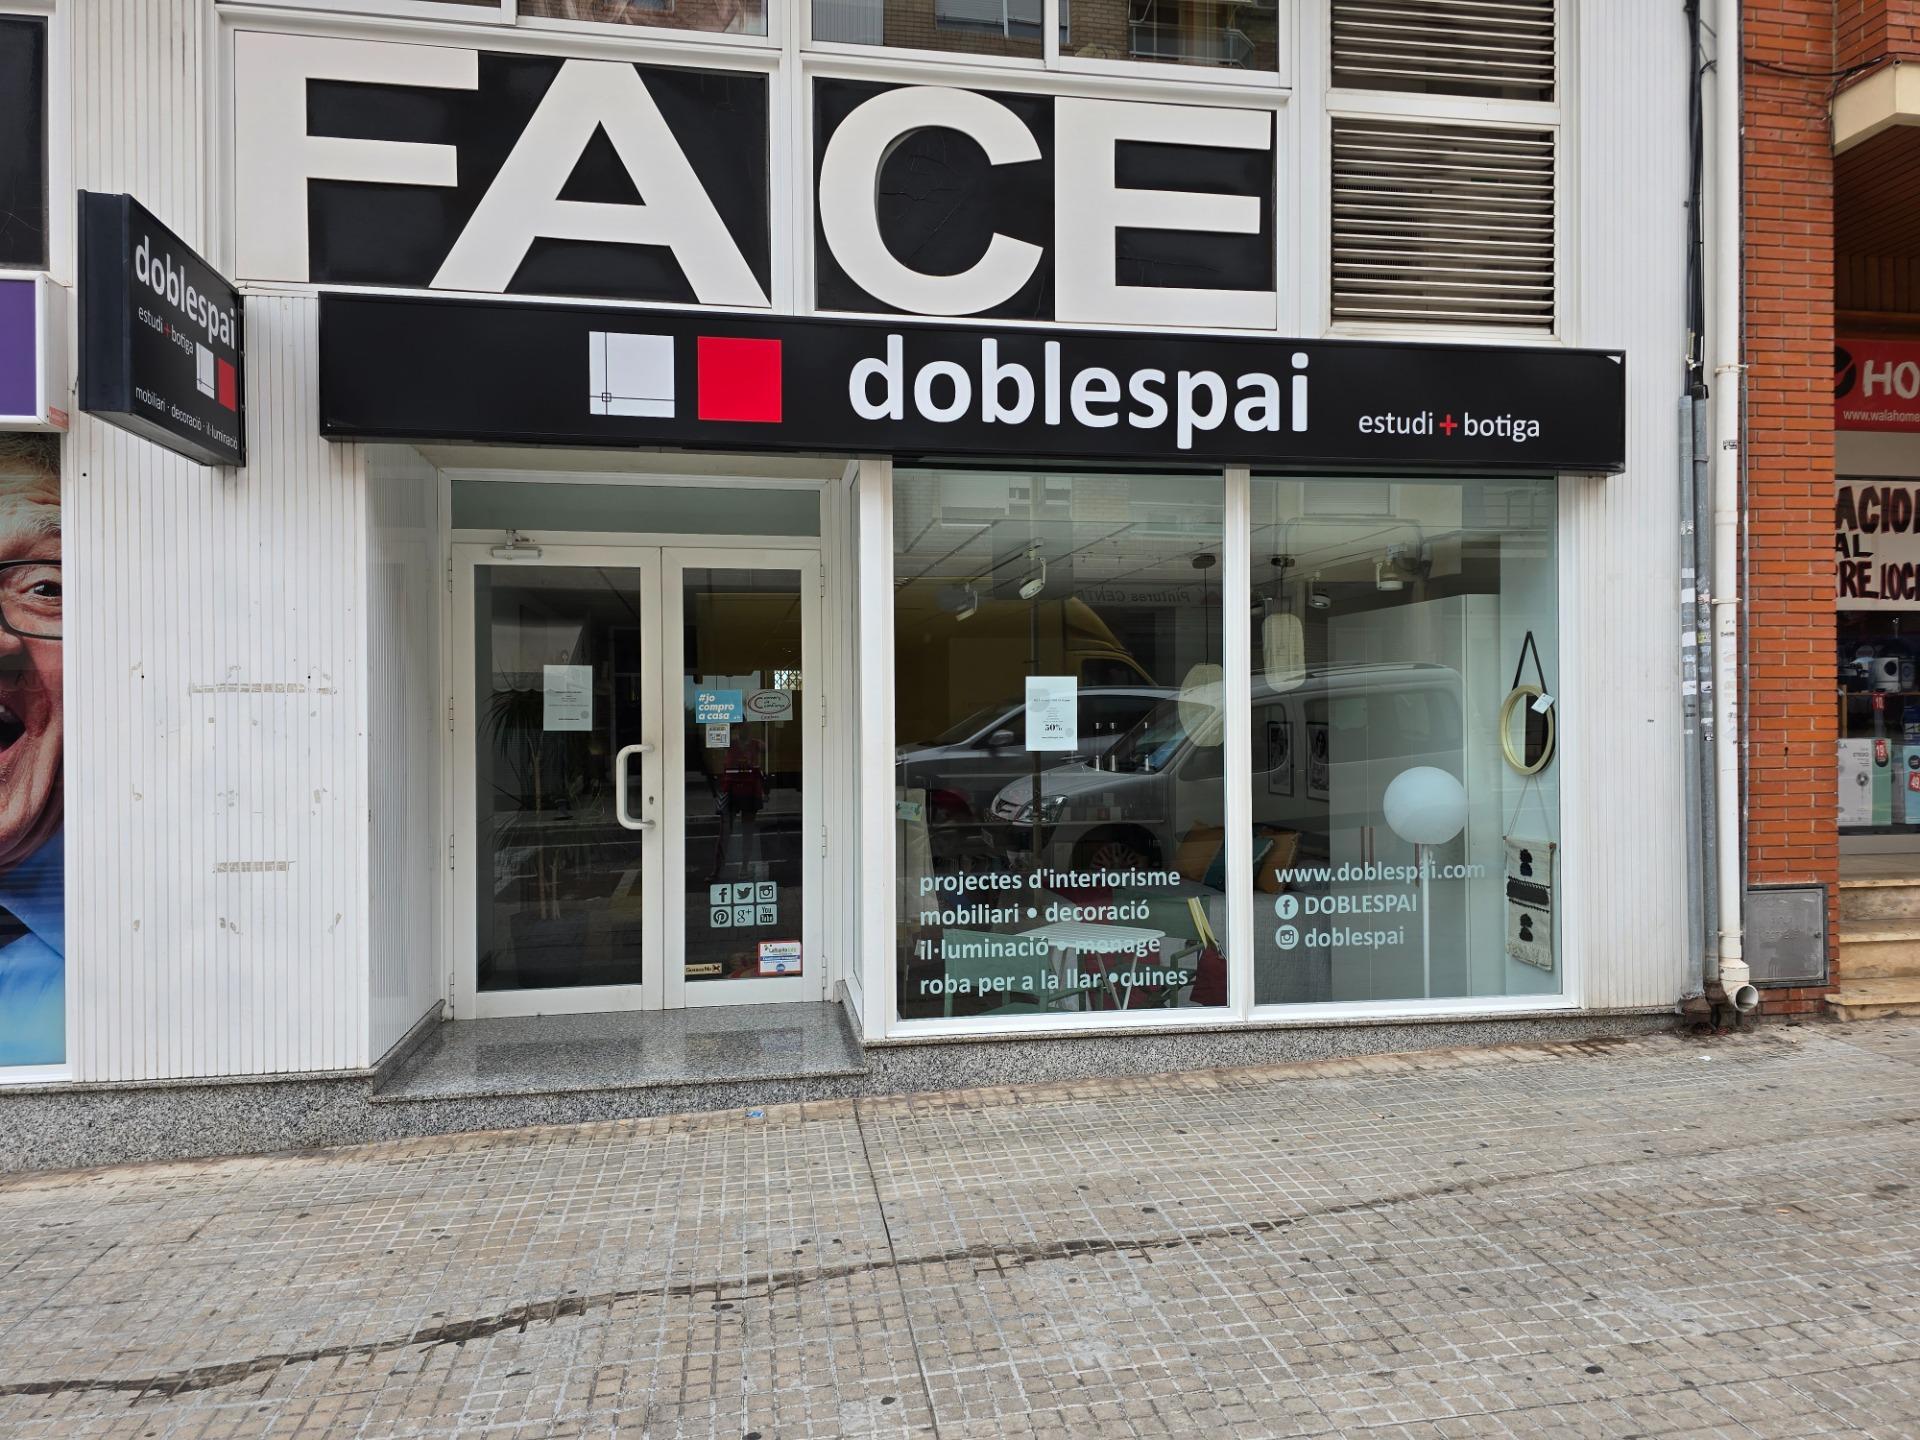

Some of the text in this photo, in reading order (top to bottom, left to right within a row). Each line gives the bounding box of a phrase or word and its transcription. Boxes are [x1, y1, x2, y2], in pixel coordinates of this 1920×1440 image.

[235, 31, 1277, 331] FACE
[134, 234, 236, 350] doblespai
[848, 333, 1310, 451] doblespai
[1863, 359, 1920, 399] HO
[135, 386, 166, 412] mobiliari
[171, 404, 202, 431] decoració
[1835, 485, 1920, 534] ACIO
[1836, 560, 1920, 601] RE LOC
[699, 693, 715, 704] #jo
[699, 703, 735, 712] compro
[920, 867, 1181, 896] projectes d'interiorisme
[1275, 861, 1486, 884] www.doblespai.com
[920, 899, 1150, 926] mobiliari decoració
[1304, 894, 1418, 915] DOBLESPAI
[1304, 926, 1405, 949] doblespai
[920, 974, 971, 995] roba
[978, 974, 1016, 997] per
[1021, 975, 1034, 990] a
[1041, 969, 1059, 990] la
[1067, 967, 1101, 989] llar
